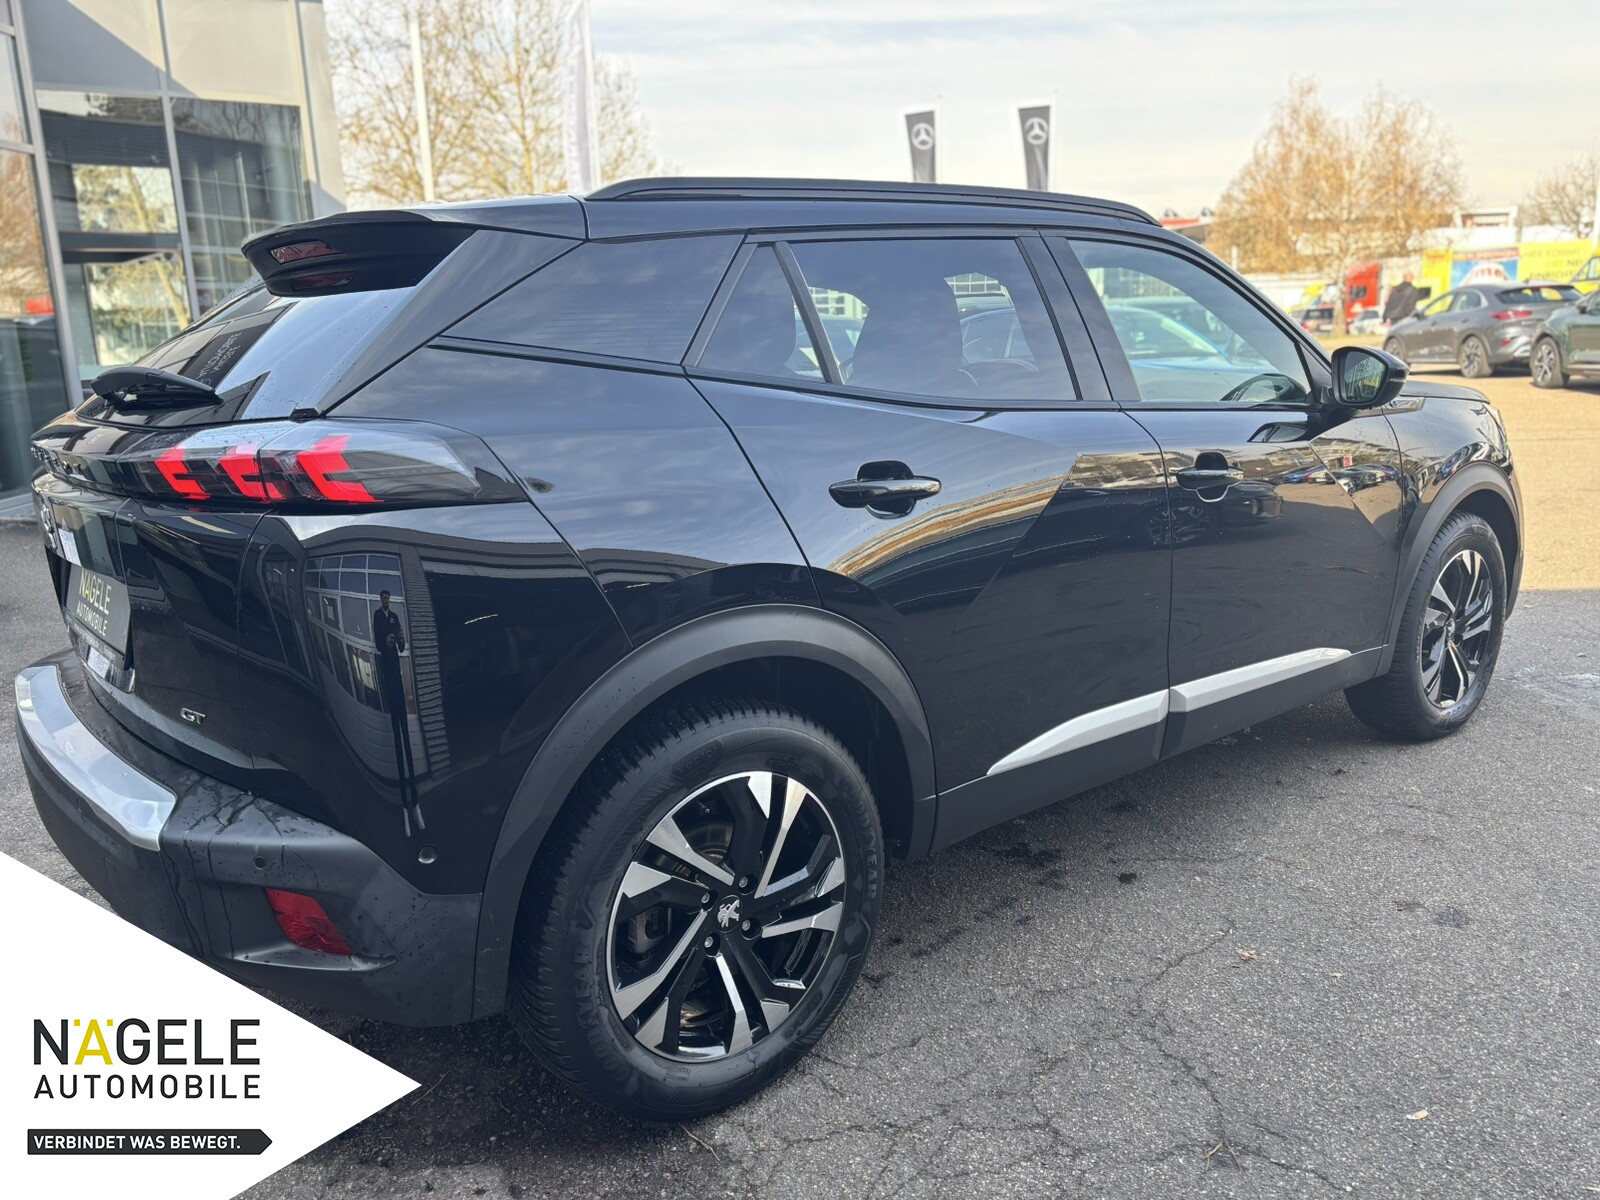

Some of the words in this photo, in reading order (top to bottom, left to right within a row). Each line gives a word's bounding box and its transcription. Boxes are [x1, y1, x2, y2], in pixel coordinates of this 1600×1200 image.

[77, 600, 108, 636] AUTOMOBILE
[180, 707, 206, 725] GT
[574, 945, 630, 1082] GOODYEAR
